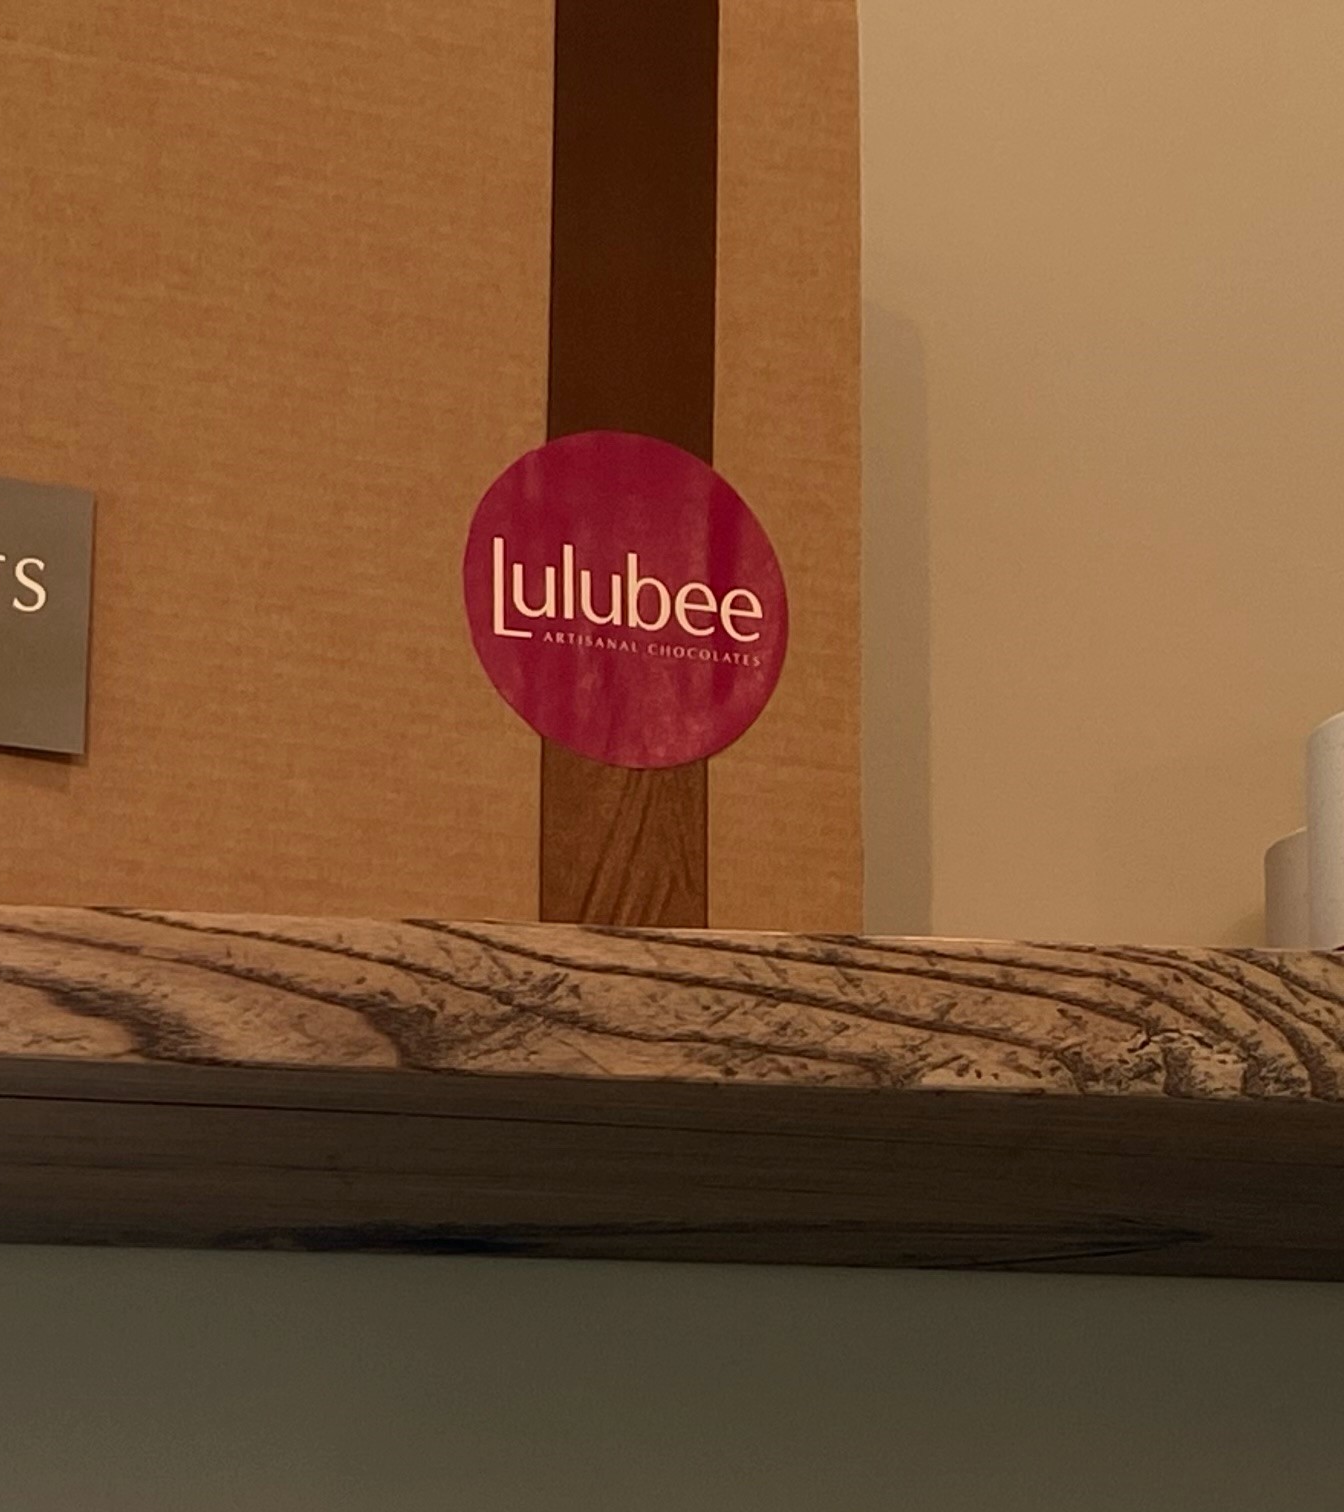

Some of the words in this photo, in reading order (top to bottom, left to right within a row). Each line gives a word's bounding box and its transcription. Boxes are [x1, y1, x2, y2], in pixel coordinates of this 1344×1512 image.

[493, 536, 763, 642] Lulubee
[543, 631, 638, 654] ARTISANAL
[647, 643, 761, 667] CHOCOLATES
